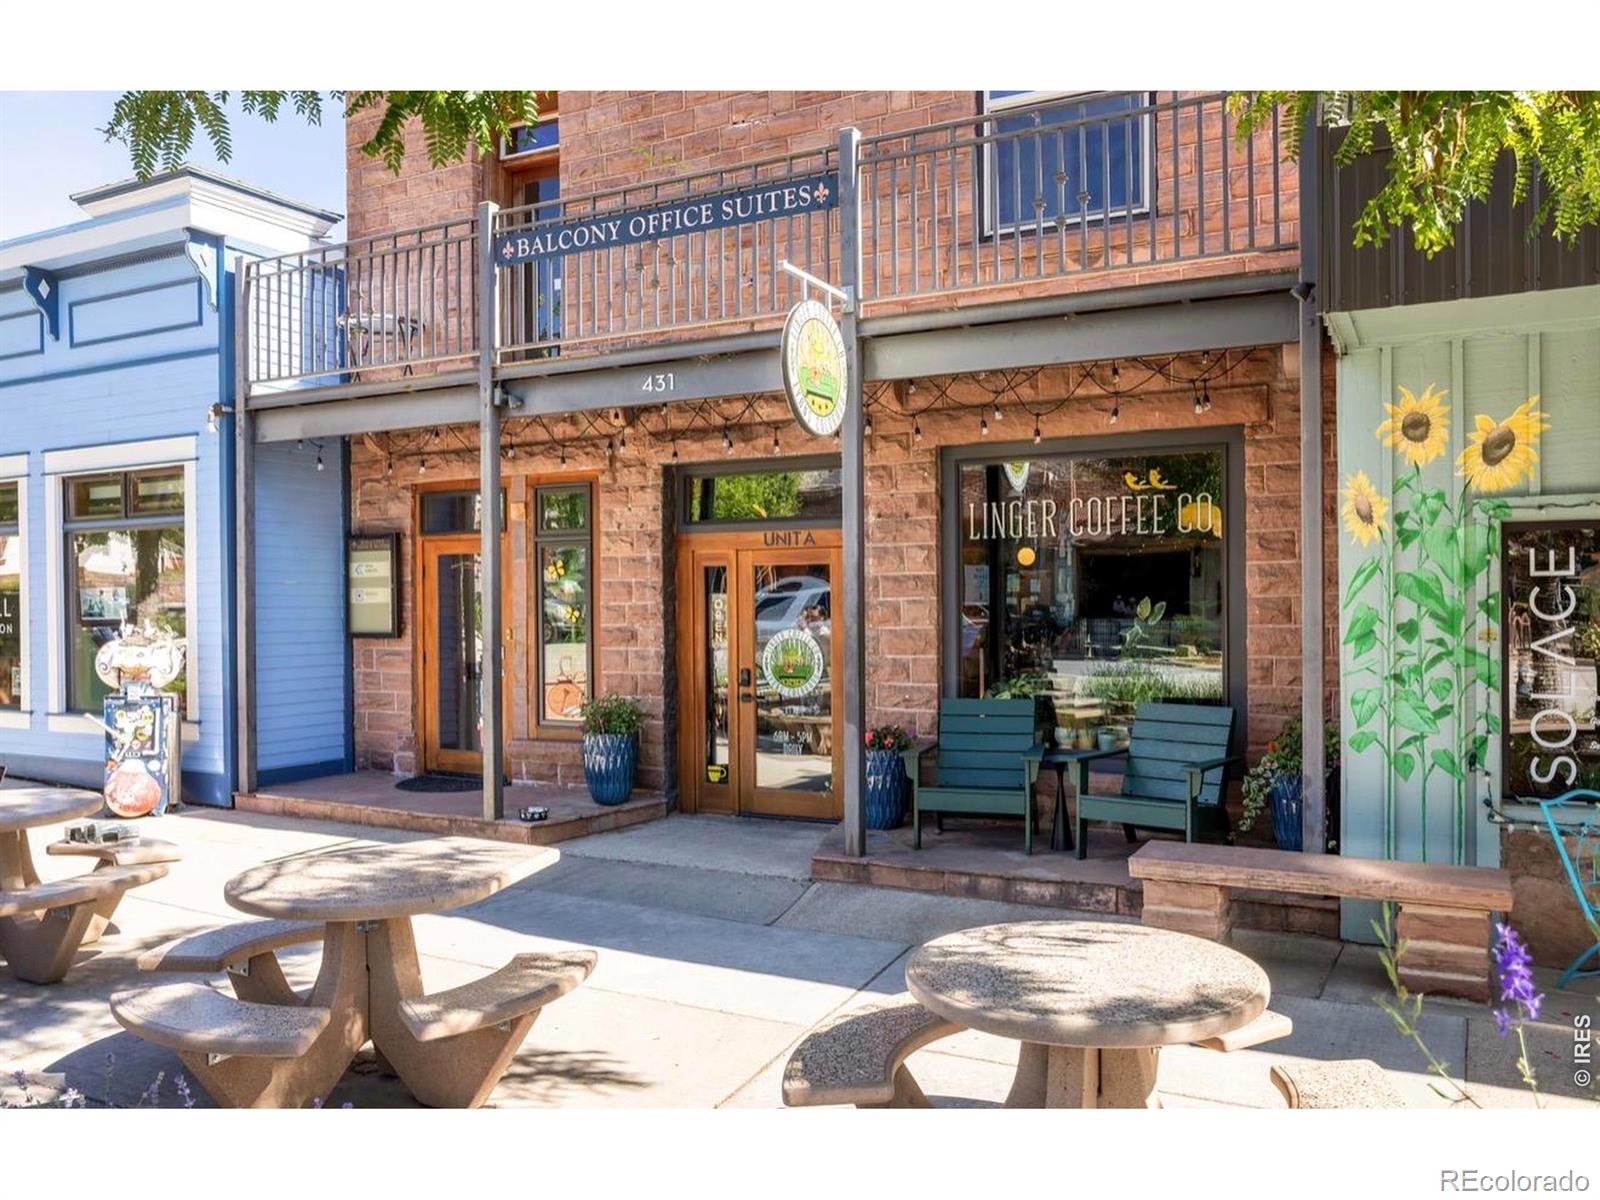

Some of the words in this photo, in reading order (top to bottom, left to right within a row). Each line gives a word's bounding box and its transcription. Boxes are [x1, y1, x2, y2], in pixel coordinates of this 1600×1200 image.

[517, 220, 621, 258] BALCONY
[629, 203, 713, 237] OFFICE
[721, 185, 811, 221] SUITES
[642, 373, 675, 392] 431
[763, 531, 801, 547] UNIT
[803, 531, 817, 546] A
[969, 499, 1057, 540] LINGER
[1069, 494, 1166, 537] COFFEE
[1529, 546, 1577, 786] SOLACE
